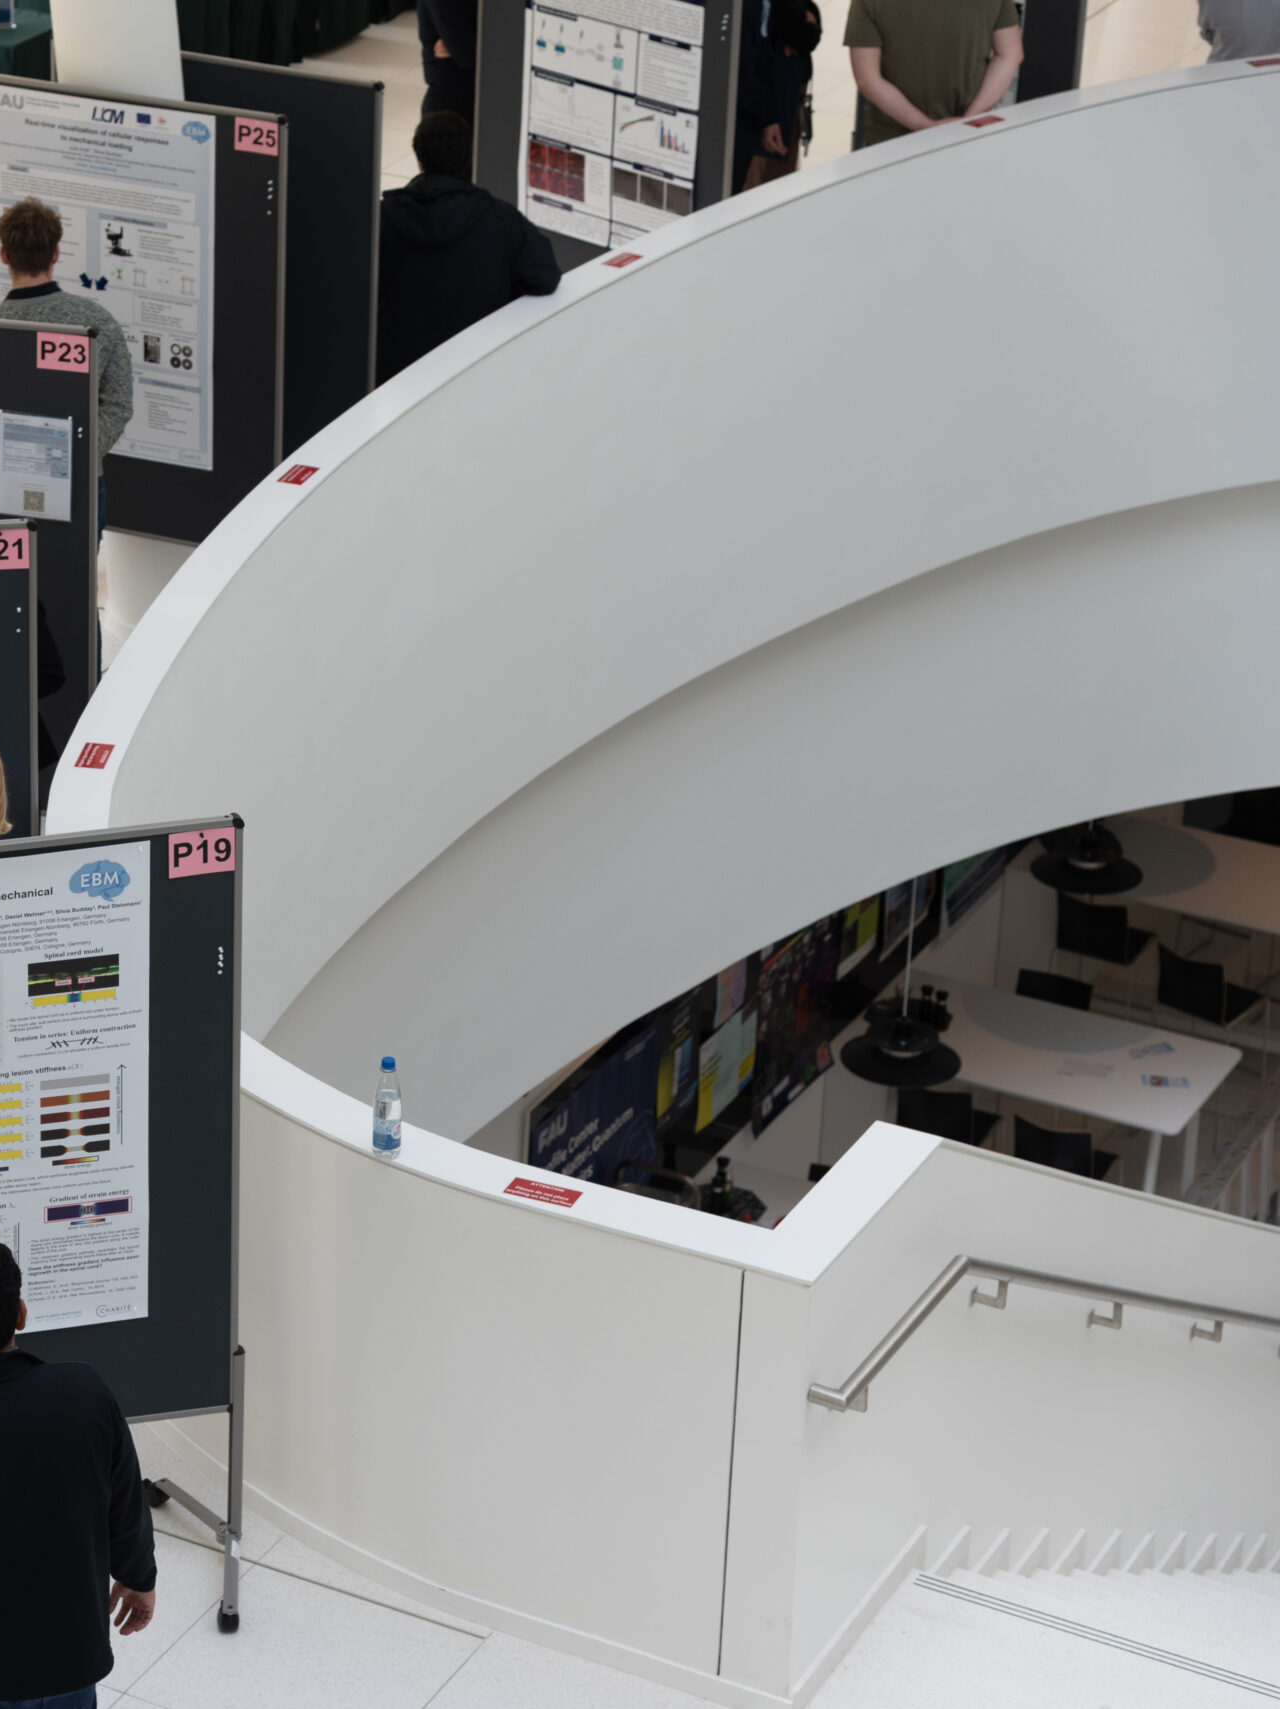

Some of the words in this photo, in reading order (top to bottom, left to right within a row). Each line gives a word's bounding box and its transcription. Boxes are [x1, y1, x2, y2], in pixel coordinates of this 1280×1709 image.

[100, 129, 108, 137] of
[186, 127, 206, 136] EBM
[238, 125, 276, 147] P25
[108, 141, 132, 152] loading
[40, 340, 86, 364] P23
[174, 838, 232, 868] P19
[80, 871, 120, 889] EBM
[5, 913, 23, 921] Daniel
[56, 907, 70, 915] Silvia
[39, 917, 56, 925] 91058
[82, 912, 107, 921] Germany
[45, 950, 66, 960] Spinal
[67, 948, 82, 957] cord
[84, 946, 104, 955] model
[14, 1033, 38, 1042] Tension
[48, 1031, 68, 1039] series:
[70, 1028, 99, 1037] Uniform
[100, 1023, 136, 1034] contraction
[12, 1068, 34, 1078] lesion
[35, 1064, 66, 1075] stiffness
[538, 1108, 568, 1154] FAU
[568, 1118, 600, 1154] Center
[530, 1182, 566, 1193] ATTENTION
[50, 1194, 80, 1203] Gradient
[81, 1192, 88, 1200] of
[88, 1191, 108, 1199] strain
[108, 1188, 130, 1198] energy
[54, 1261, 76, 1269] stiffness
[78, 1259, 100, 1268] gradient
[101, 1256, 125, 1264] influence
[28, 1270, 52, 1278] regrowth
[70, 1264, 86, 1273] spinal
[87, 1262, 104, 1270] cord?
